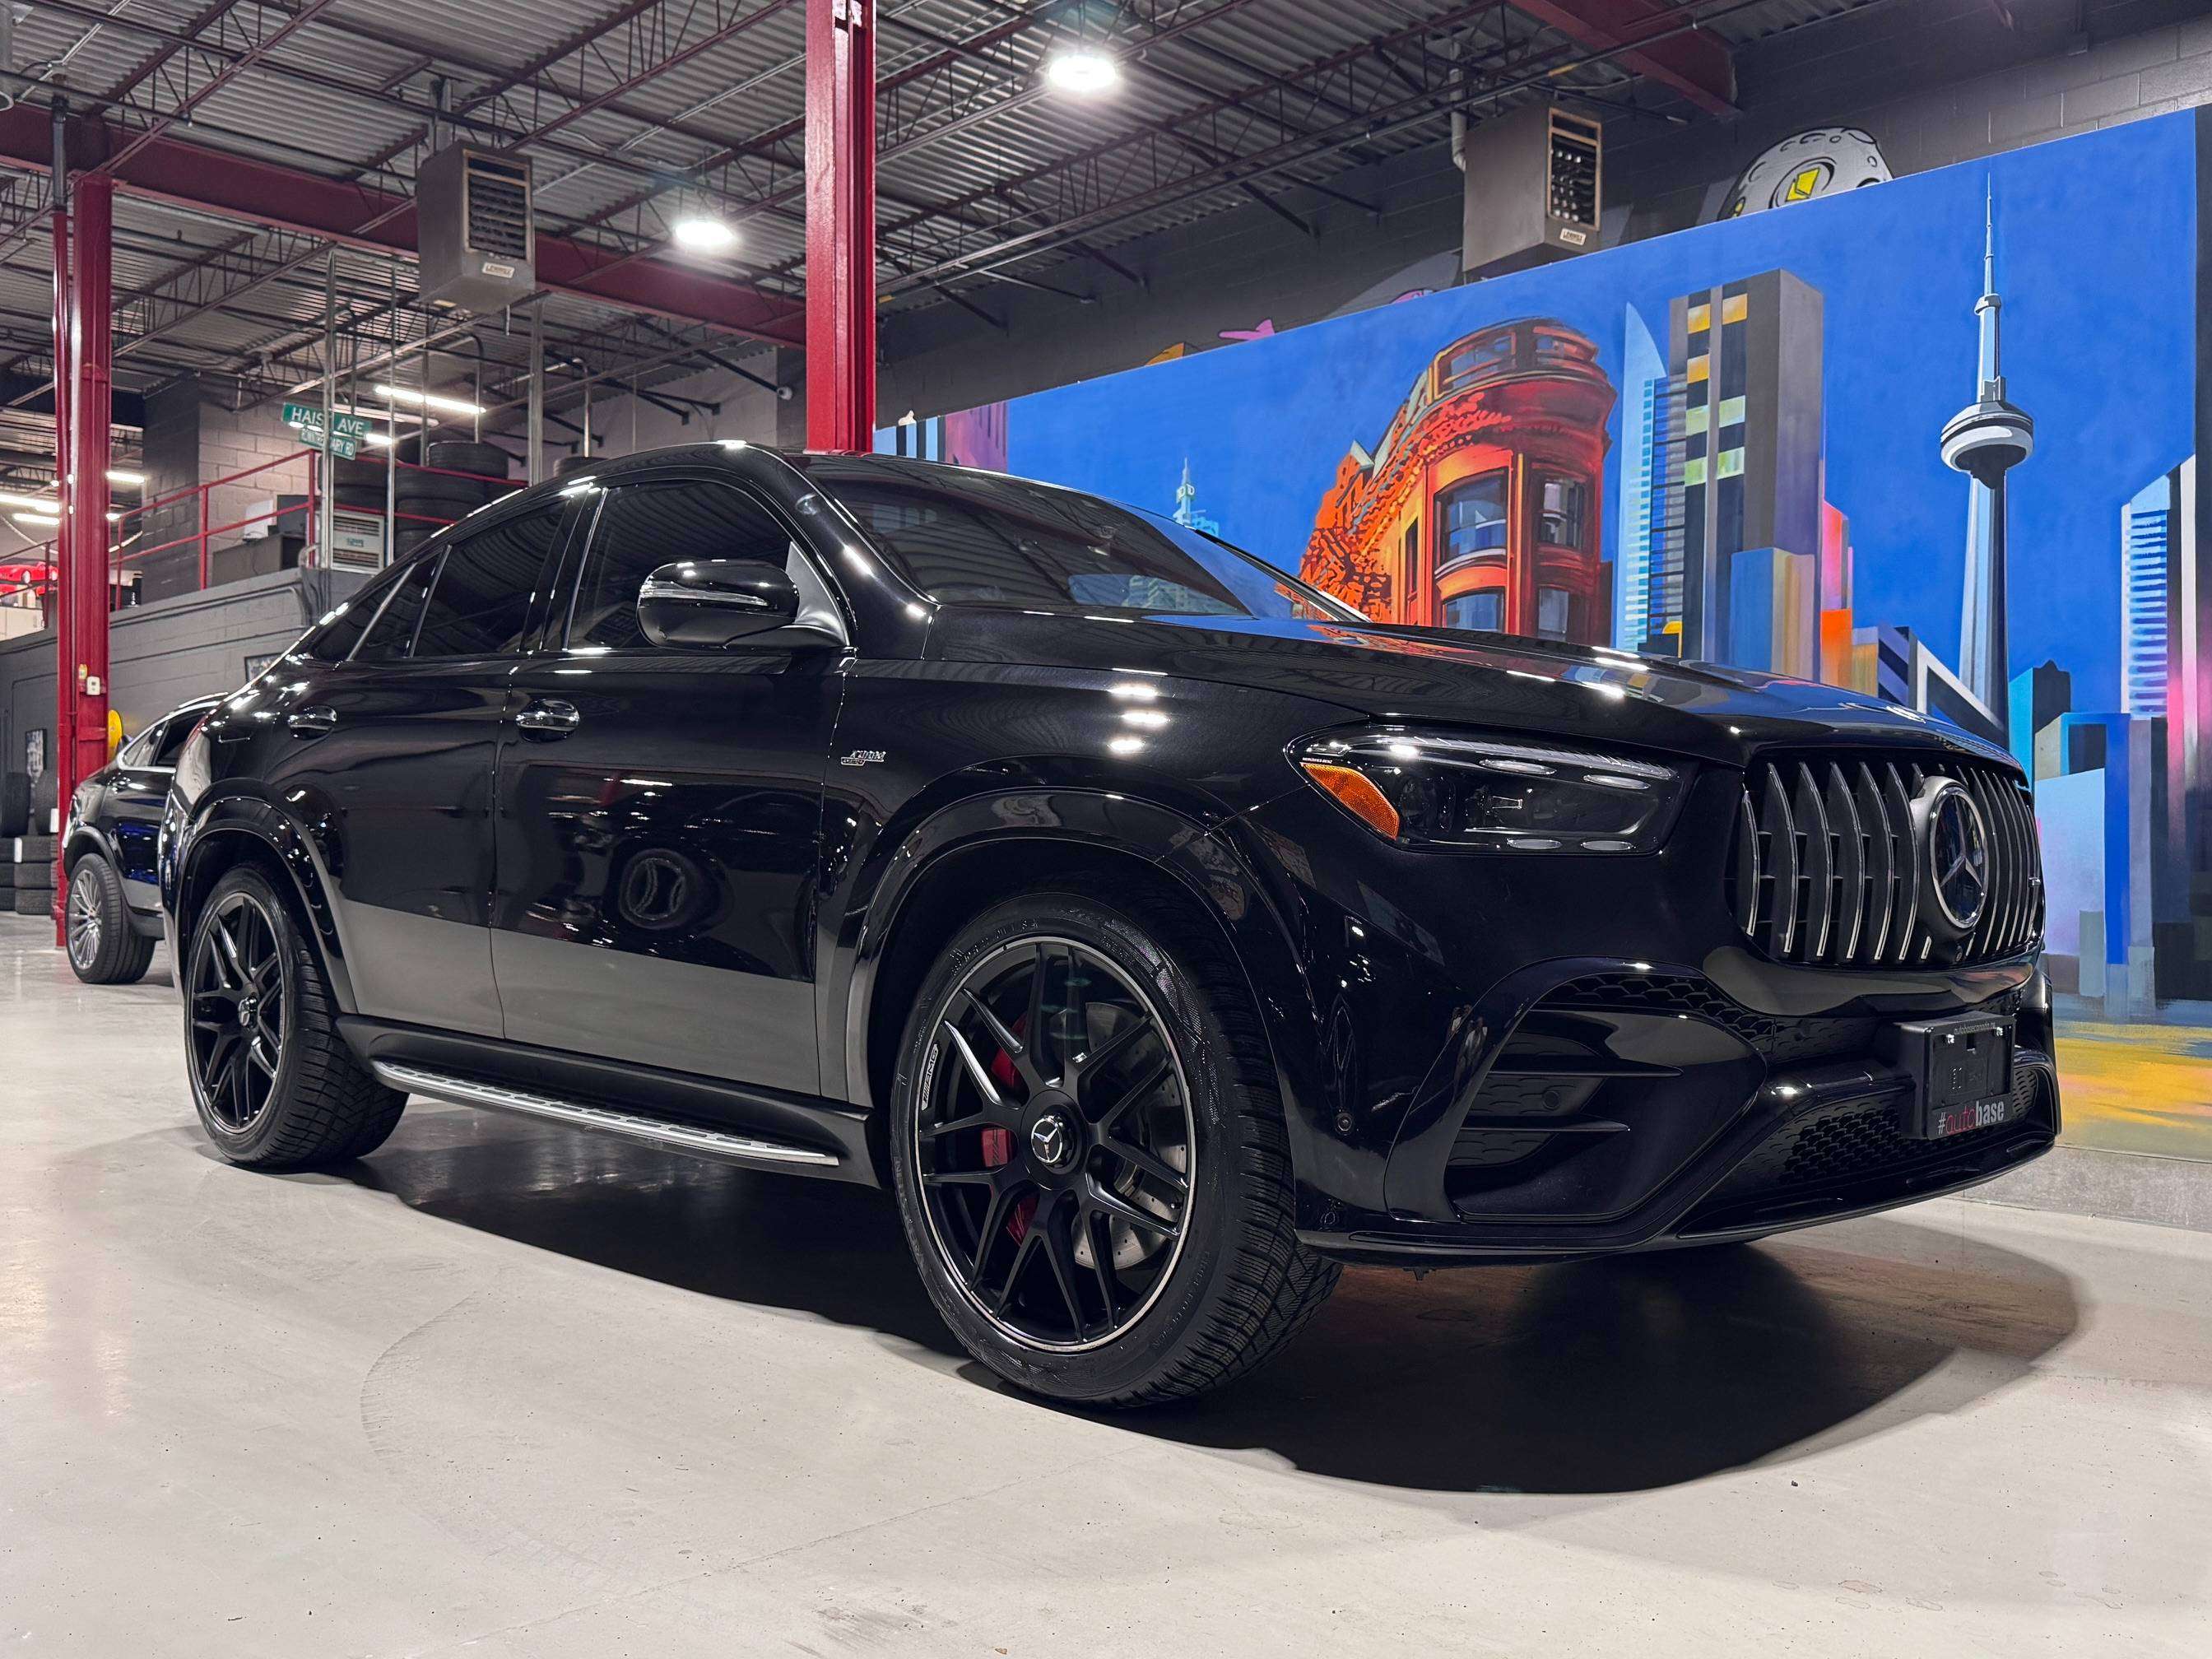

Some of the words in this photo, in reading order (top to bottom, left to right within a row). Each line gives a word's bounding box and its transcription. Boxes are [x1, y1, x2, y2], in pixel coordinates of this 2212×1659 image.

[291, 407, 330, 425] HAIS
[337, 418, 365, 434] AVE
[1938, 1099, 2005, 1136] #autobase
